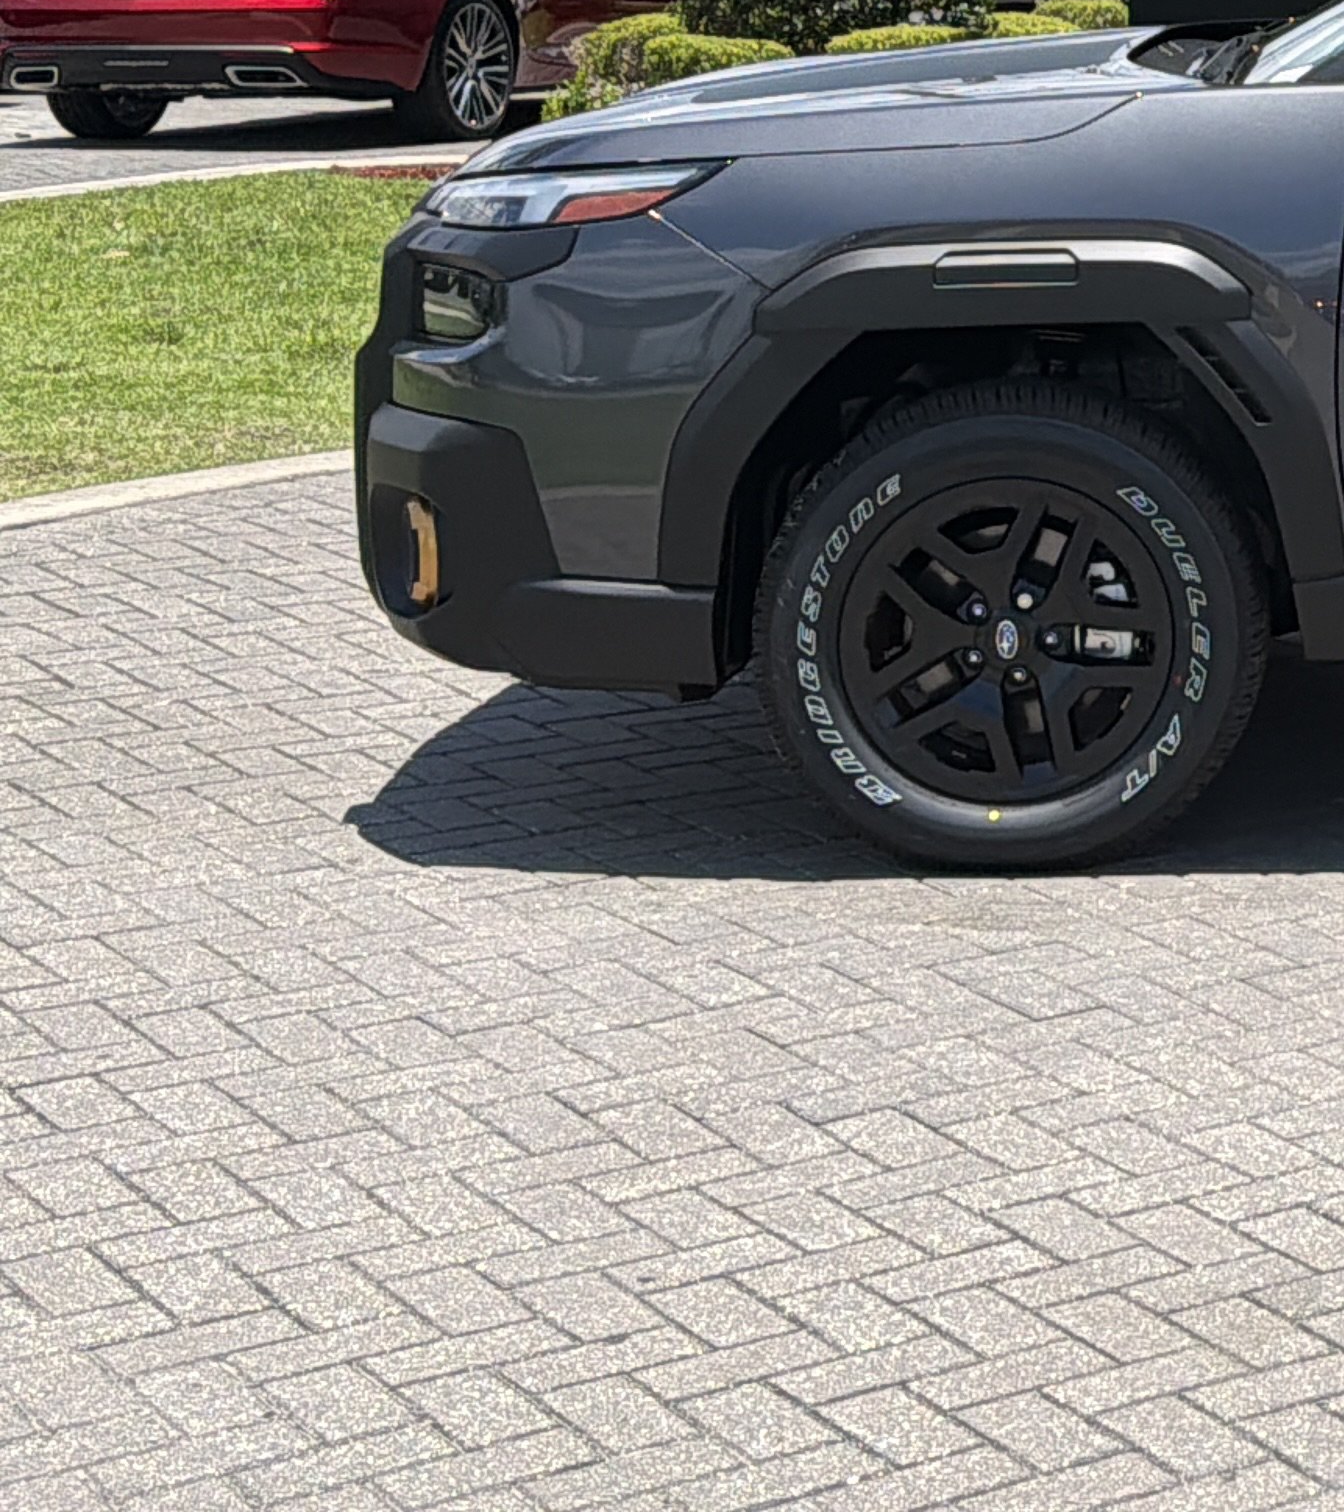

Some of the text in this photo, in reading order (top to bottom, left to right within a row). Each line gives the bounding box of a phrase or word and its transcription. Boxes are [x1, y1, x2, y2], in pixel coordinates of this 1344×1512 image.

[795, 473, 903, 807] BRIDGESTONE
[1117, 485, 1213, 805] DUELER A/T
